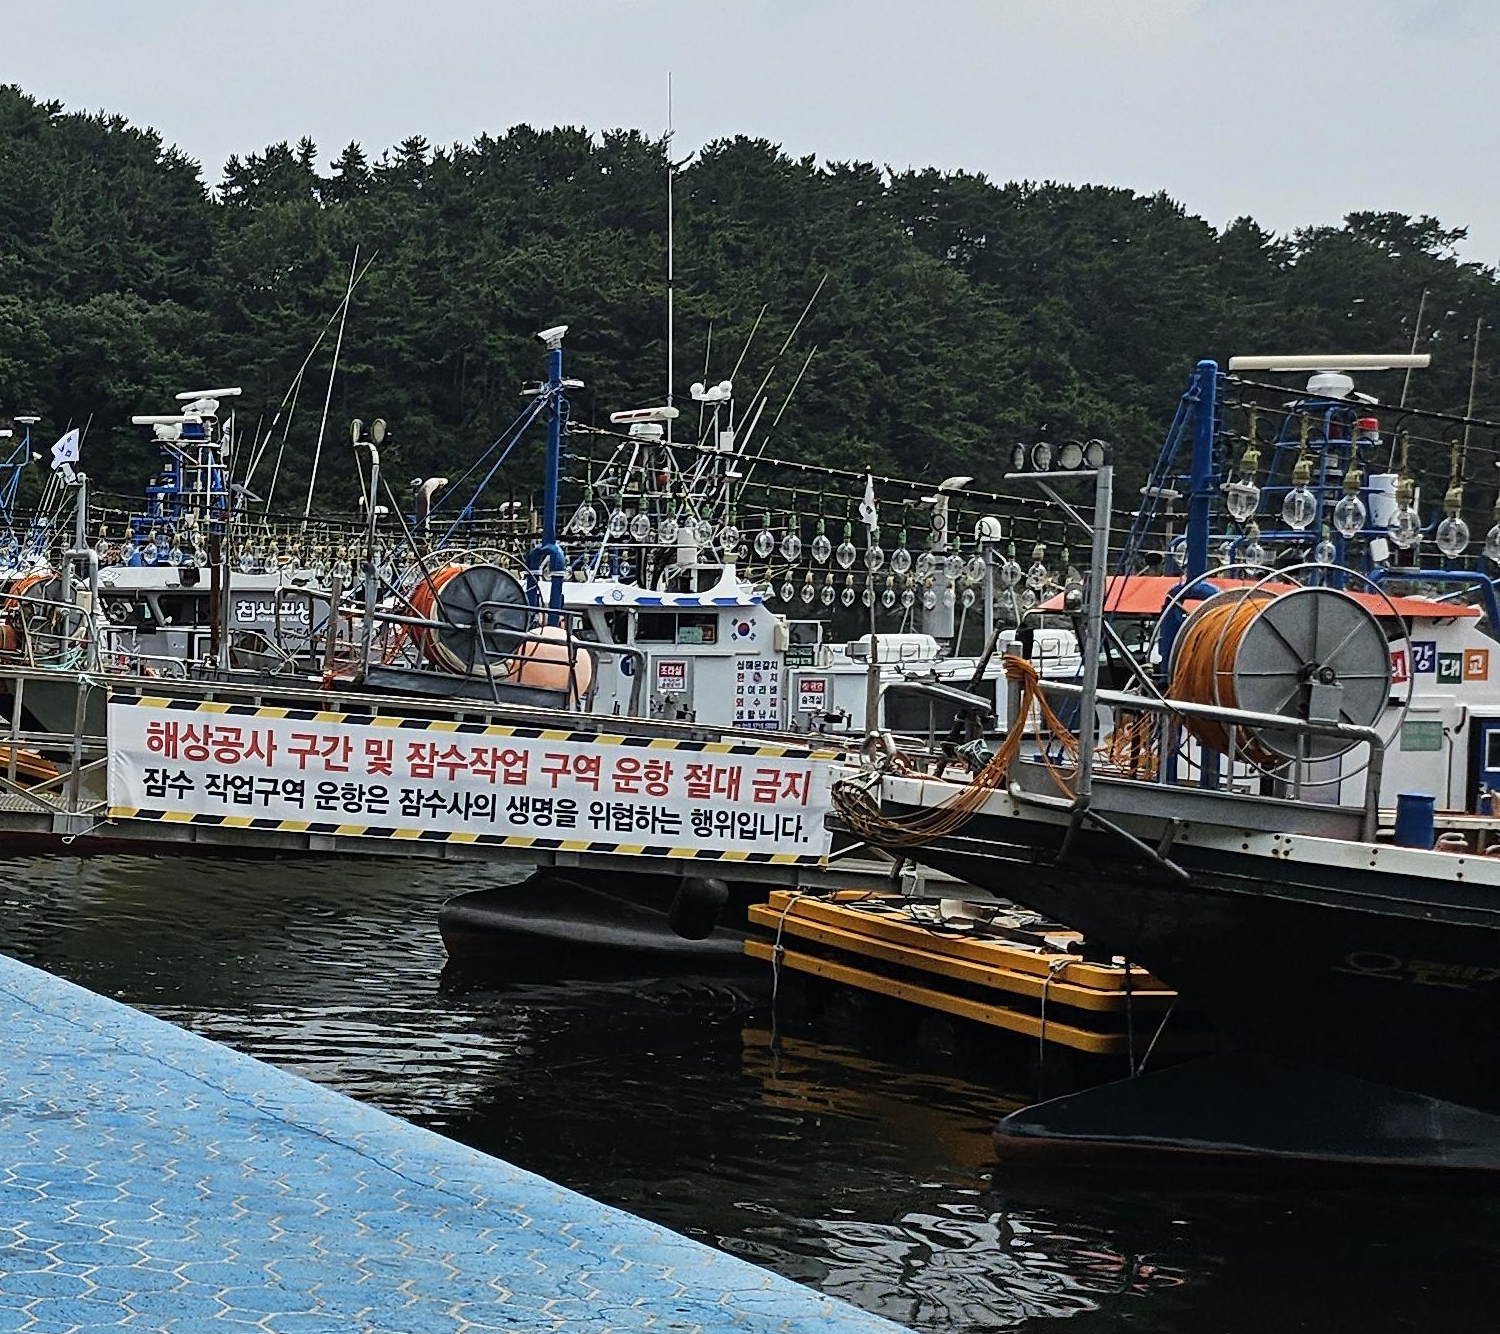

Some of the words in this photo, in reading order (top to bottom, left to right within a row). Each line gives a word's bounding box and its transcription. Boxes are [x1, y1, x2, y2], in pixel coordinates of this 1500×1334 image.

[146, 721, 277, 766] 해상공사
[287, 732, 353, 772] 구간
[363, 738, 394, 777] 및
[405, 742, 530, 786] 잠수작업
[540, 752, 602, 792] 구역
[611, 756, 675, 798] 운항
[683, 763, 742, 802] 절대
[751, 767, 812, 806] 금지
[142, 767, 195, 800] 잠수
[204, 773, 306, 809] 작업구역
[313, 780, 390, 815] 운항은
[398, 787, 497, 823] 잠수사의
[505, 794, 579, 829] 생명을
[587, 801, 683, 836] 위협하는
[690, 807, 810, 844] 행위입니다.
